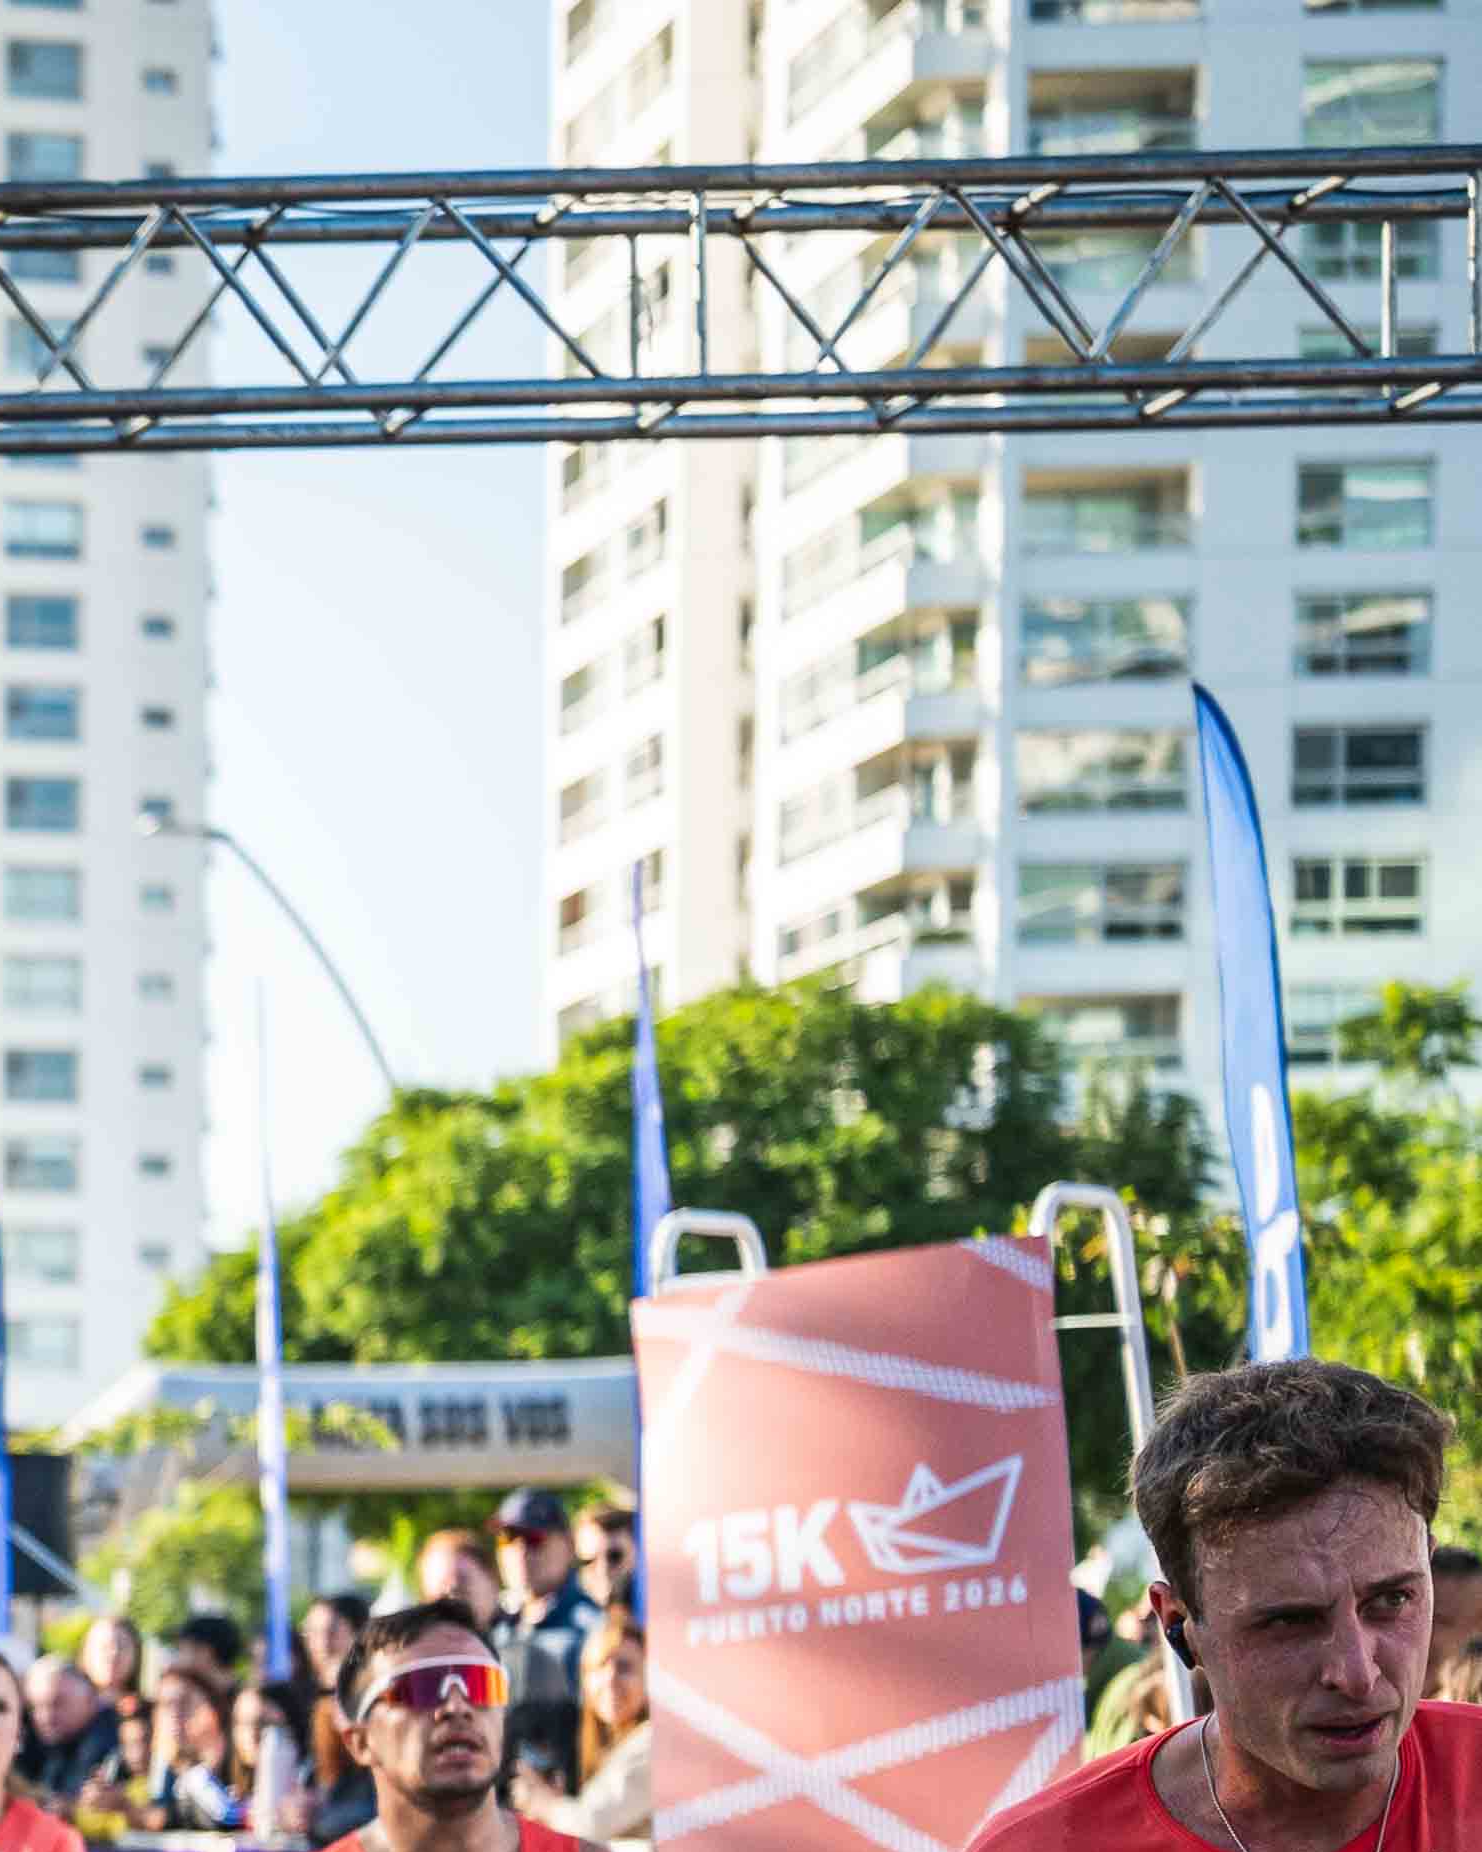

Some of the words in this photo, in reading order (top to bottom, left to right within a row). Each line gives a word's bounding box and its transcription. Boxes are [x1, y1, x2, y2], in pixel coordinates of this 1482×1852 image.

[681, 1499, 847, 1605] 15K
[687, 1603, 809, 1649] PUERTO
[818, 1585, 931, 1628] NORTE
[943, 1573, 1029, 1613] 2026
